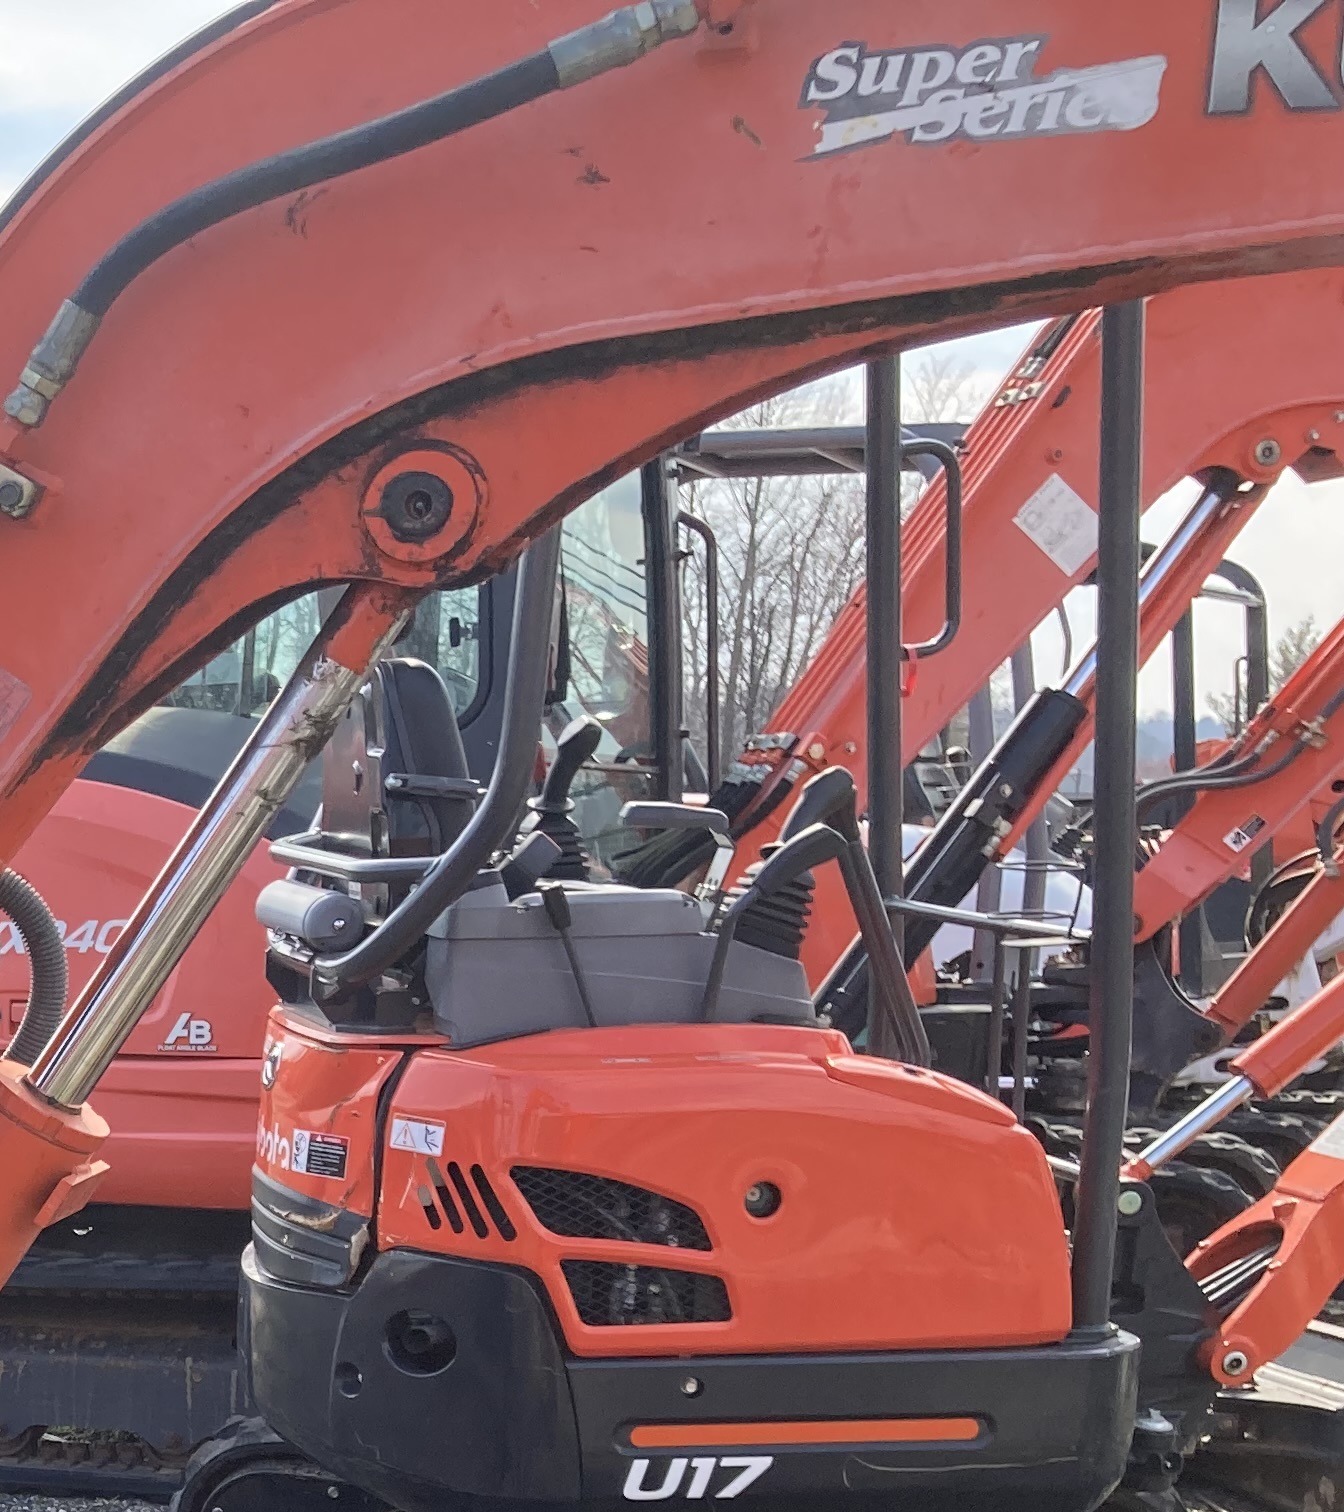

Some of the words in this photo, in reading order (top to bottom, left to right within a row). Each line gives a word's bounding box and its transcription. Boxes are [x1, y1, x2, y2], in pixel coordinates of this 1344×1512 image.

[808, 40, 1039, 107] Super
[1210, 0, 1344, 113] K
[164, 1012, 213, 1046] AB
[623, 1456, 774, 1500] U17
